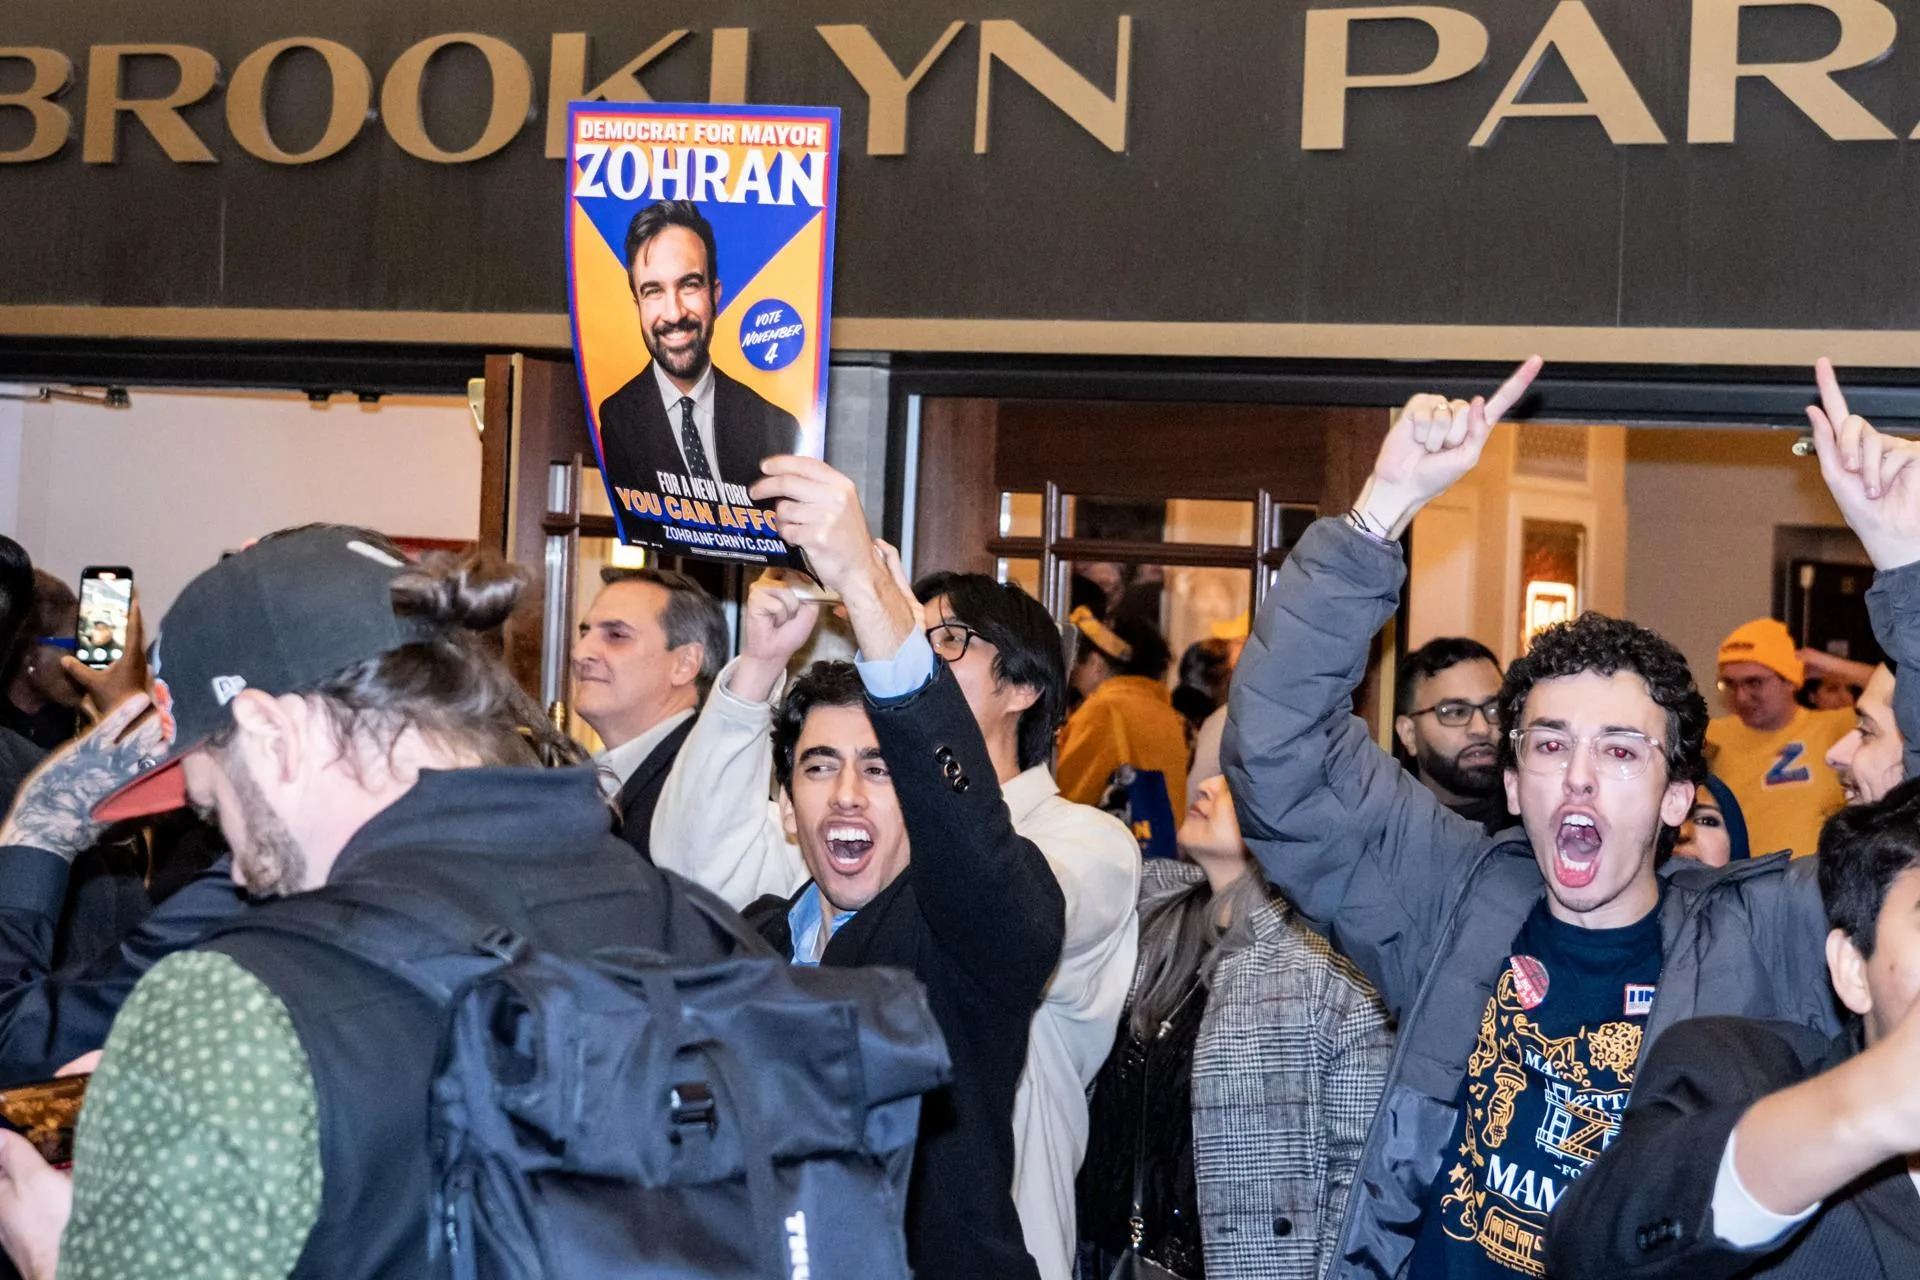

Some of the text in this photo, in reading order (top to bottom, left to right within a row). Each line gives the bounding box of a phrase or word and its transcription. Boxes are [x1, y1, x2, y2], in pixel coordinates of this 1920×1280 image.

[1301, 0, 1920, 149] PAR
[580, 119, 823, 147] DEMOCRAT FOR MAYOR
[573, 143, 829, 208] ZOHRAN
[755, 309, 783, 328] VOTE
[741, 323, 803, 348] NOVEMBER
[764, 342, 779, 364] 4
[656, 470, 753, 507] FOR A NEW YORK
[614, 486, 663, 517] YOU
[664, 495, 716, 525] CAN
[662, 525, 788, 554] ZOHRANFORNYC.COM
